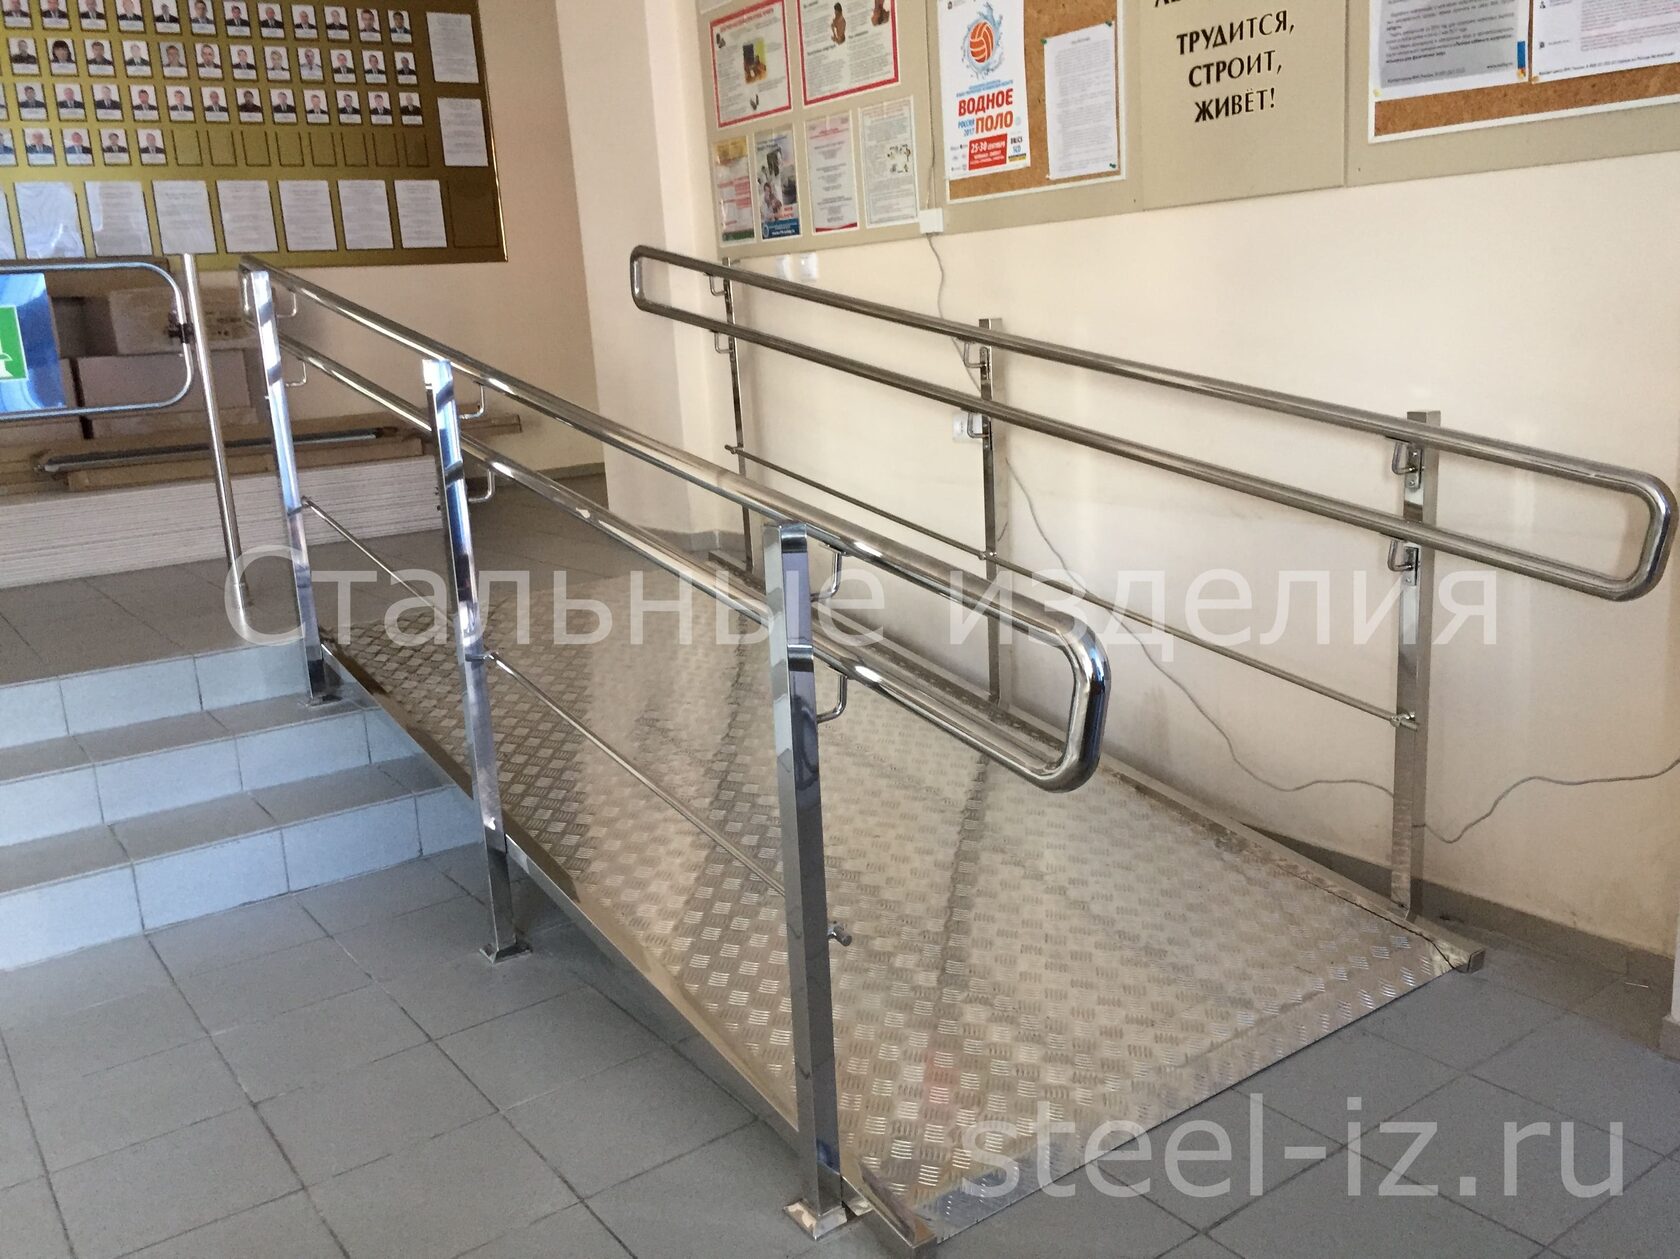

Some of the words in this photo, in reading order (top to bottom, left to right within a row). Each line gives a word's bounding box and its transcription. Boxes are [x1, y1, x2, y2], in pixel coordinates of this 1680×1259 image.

[1176, 10, 1295, 55] ТРУДИТСЯ,
[1188, 50, 1282, 88] СТРОИТ,
[958, 88, 1014, 117] ВОДНОЕ
[1195, 87, 1275, 123] ЖИВЁТ!
[975, 110, 1014, 134] ПОЛО
